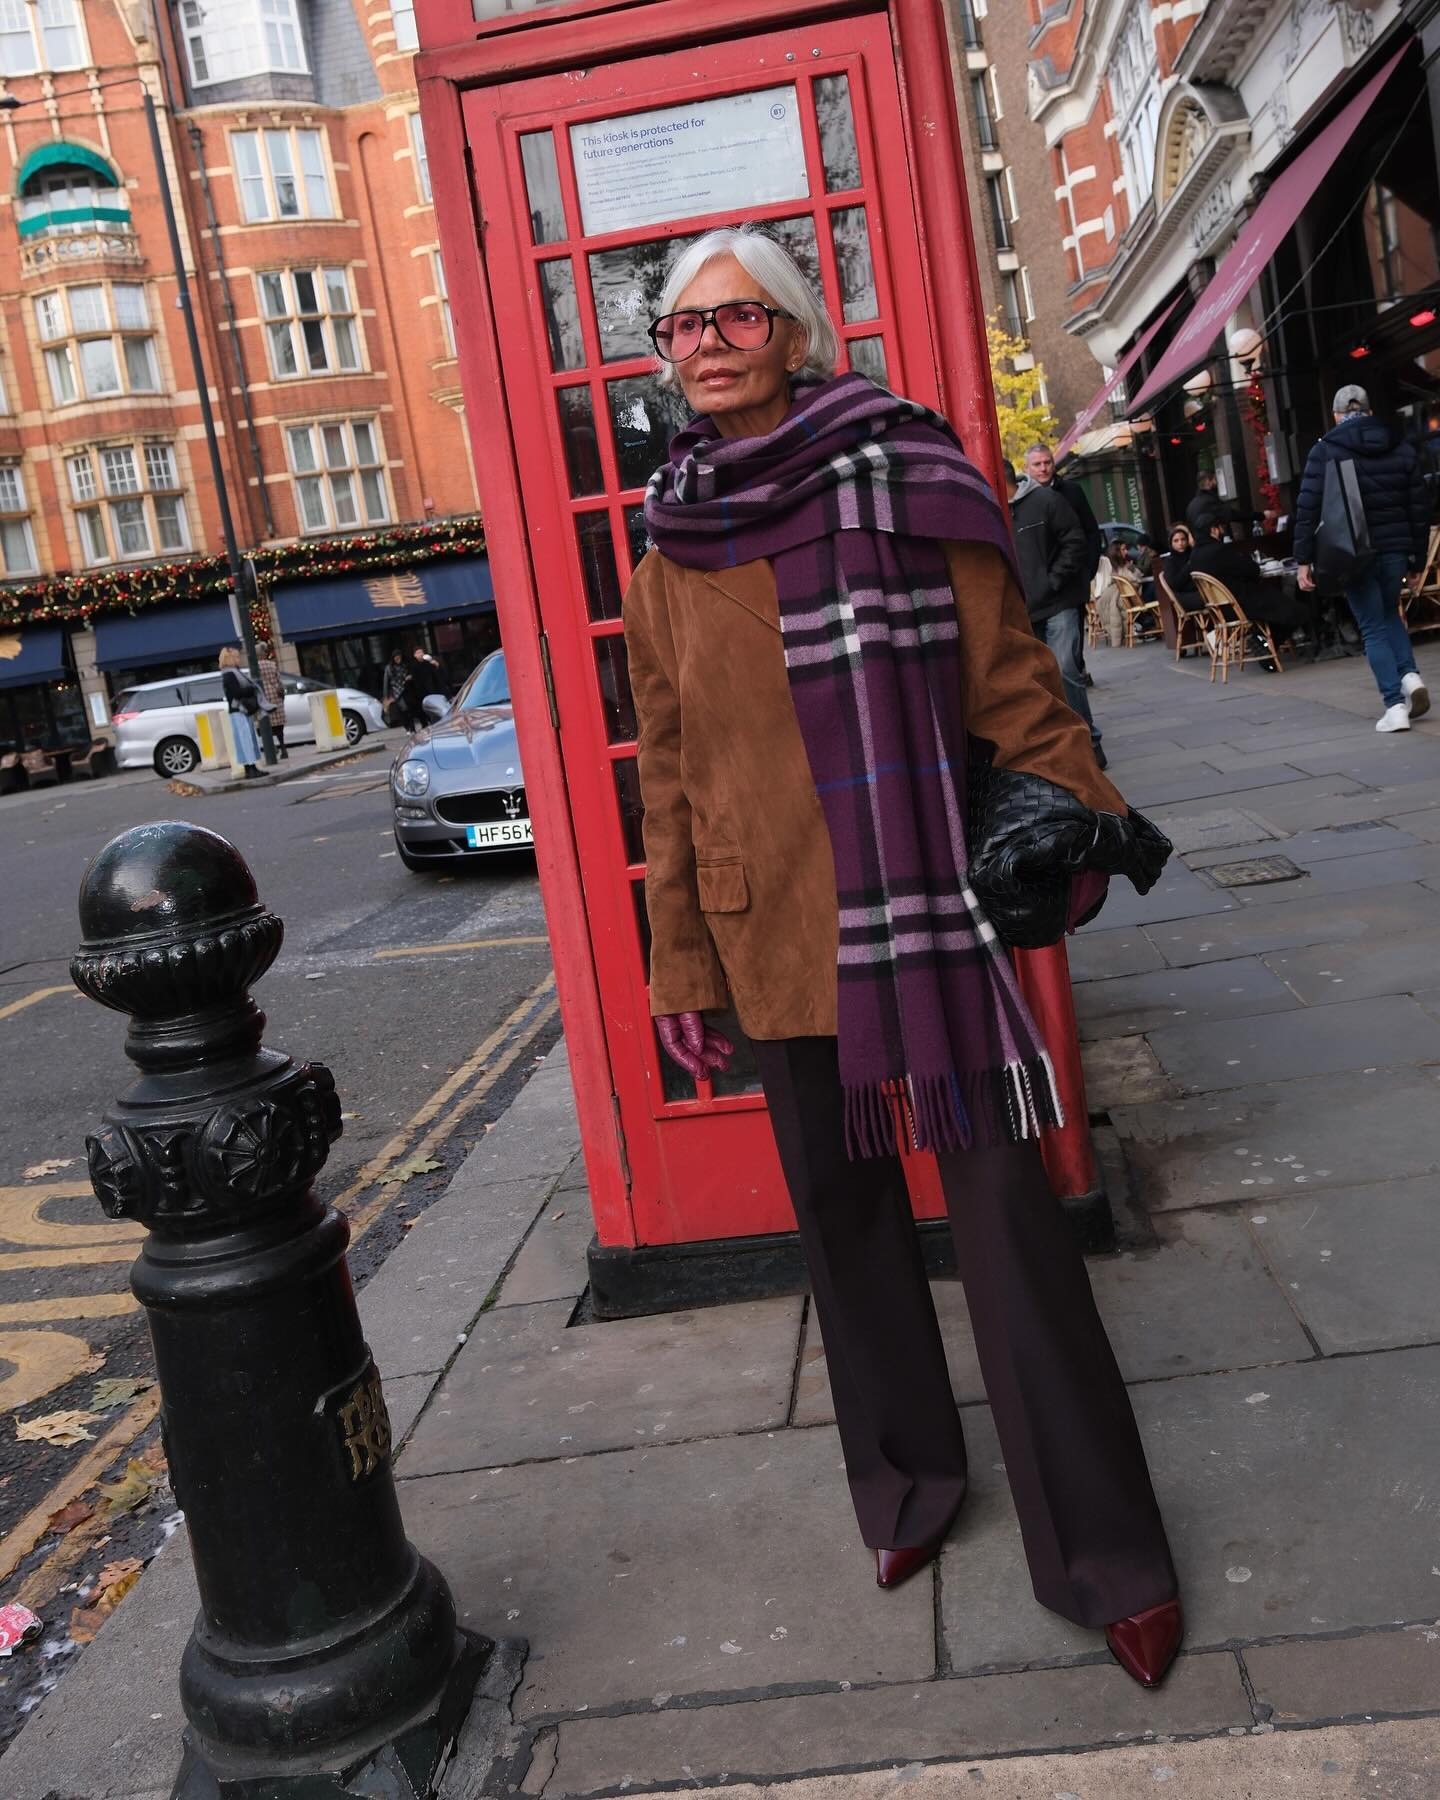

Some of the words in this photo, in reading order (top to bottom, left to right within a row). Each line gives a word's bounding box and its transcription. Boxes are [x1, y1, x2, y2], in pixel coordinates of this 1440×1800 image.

[773, 108, 782, 116] BT
[581, 136, 602, 147] This
[603, 131, 629, 144] kiosk
[630, 129, 639, 138] is
[640, 119, 689, 138] protected
[690, 118, 705, 128] for
[583, 147, 613, 160] future
[614, 137, 674, 156] generations
[1127, 477, 1140, 511] DAVID
